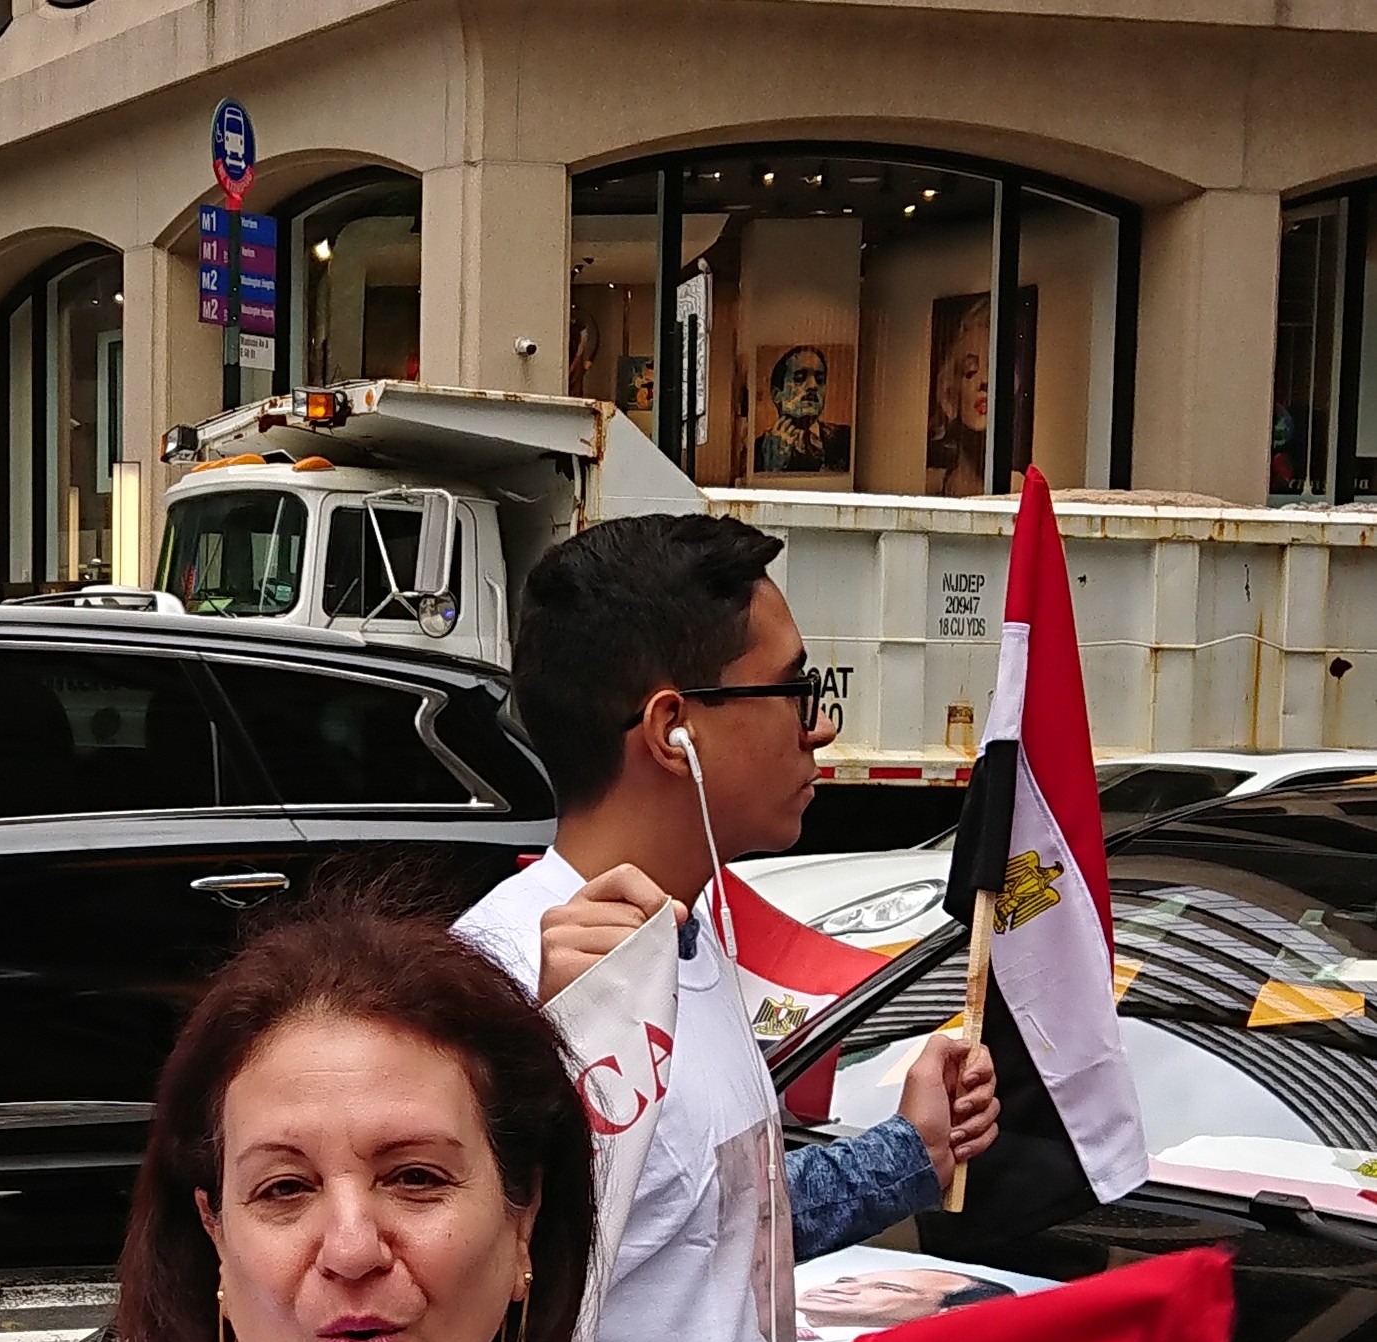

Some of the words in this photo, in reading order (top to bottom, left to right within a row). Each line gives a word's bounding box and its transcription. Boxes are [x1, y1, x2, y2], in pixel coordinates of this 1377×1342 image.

[201, 211, 217, 232] M1
[202, 240, 218, 261] M1
[201, 269, 218, 291] M2
[202, 298, 219, 320] M2
[942, 572, 986, 593] NJDEP
[944, 596, 981, 615] 20947
[938, 618, 949, 637] 18
[950, 618, 965, 637] CU
[967, 618, 987, 637] YDS
